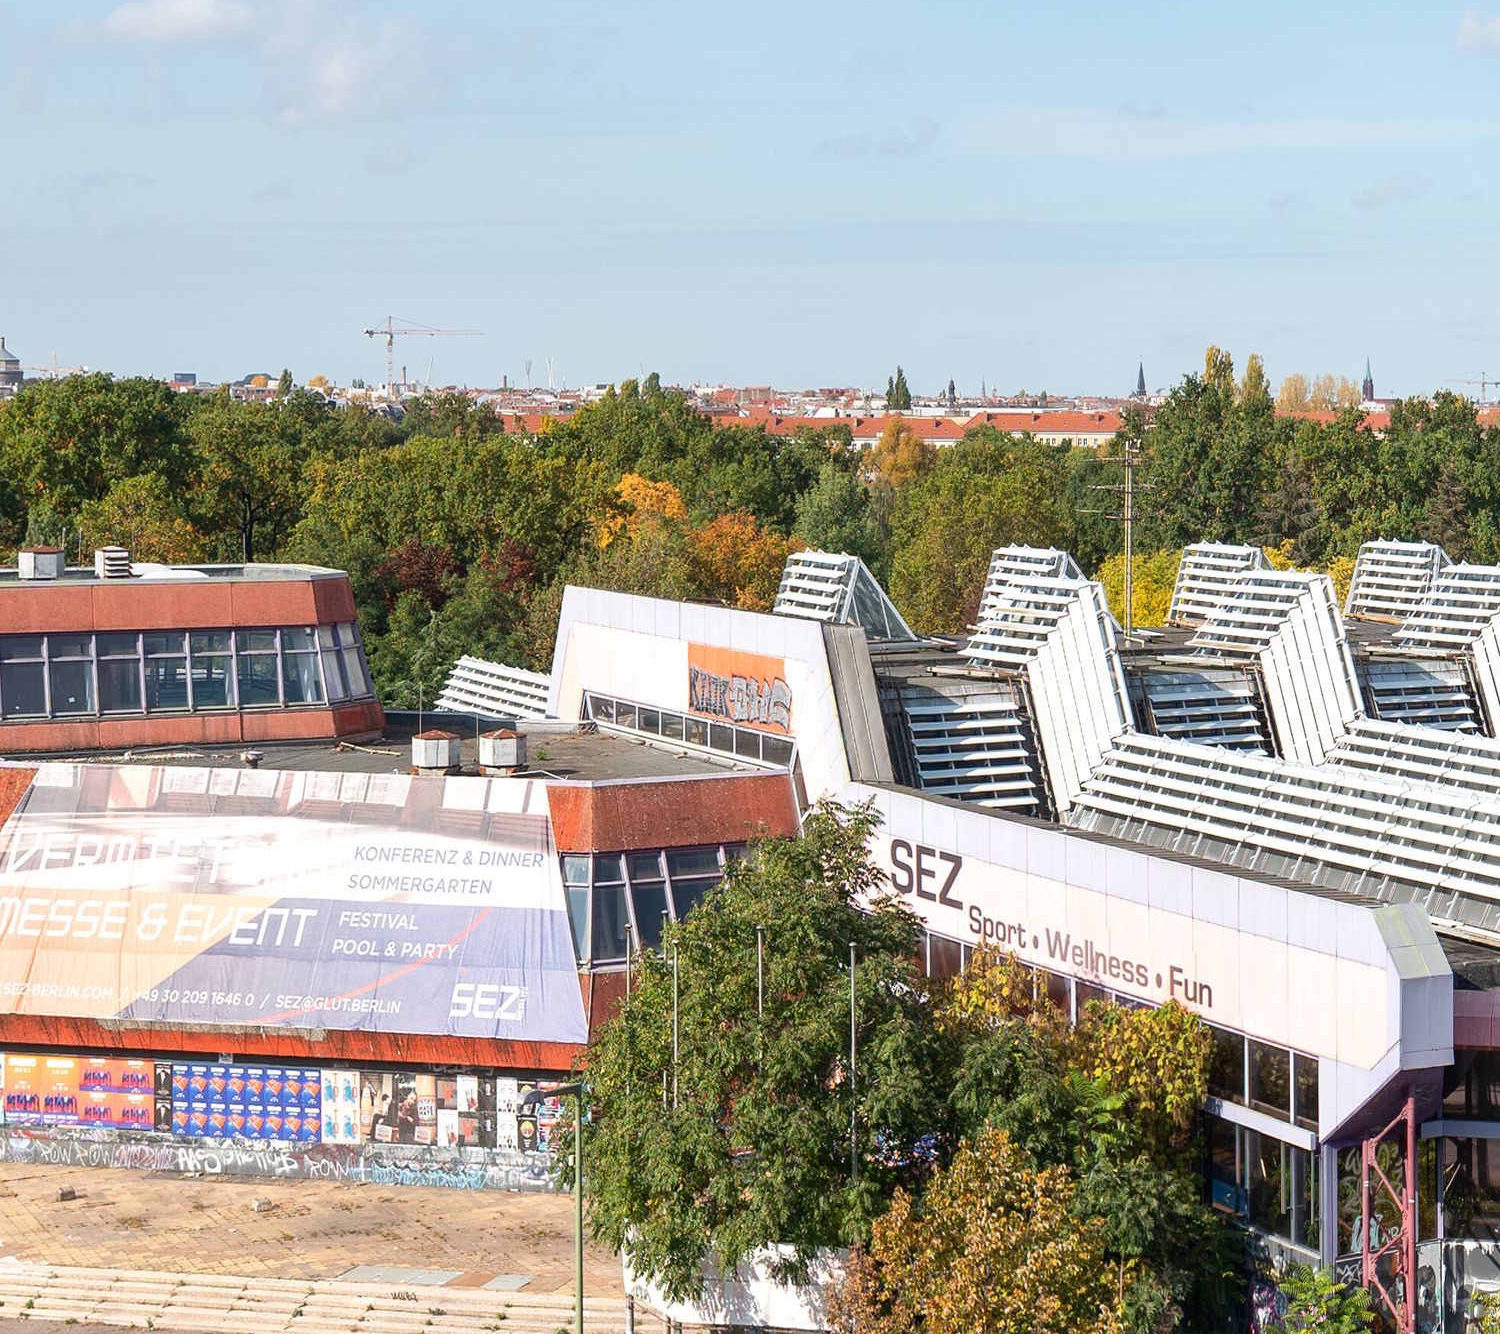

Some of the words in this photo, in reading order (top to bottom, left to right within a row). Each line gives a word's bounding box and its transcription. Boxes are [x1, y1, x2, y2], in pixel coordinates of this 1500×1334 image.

[354, 845, 459, 866] KONFERENZ
[462, 850, 474, 866] &
[479, 851, 546, 868] DINNER
[347, 873, 493, 895] SOMMERGARTEN
[890, 838, 964, 911] SEZ
[136, 902, 169, 941] &
[173, 903, 318, 947] EVENT
[338, 910, 419, 931] FESTIVAL
[331, 938, 380, 957] POOL
[384, 941, 397, 957] &
[400, 942, 460, 960] PARTY
[968, 904, 1027, 950] Sport
[1045, 926, 1149, 988] Wellness
[1169, 964, 1213, 1009] Fun
[161, 989, 179, 1004] 30
[181, 990, 207, 1005] 209
[210, 991, 242, 1007] 1646
[274, 994, 402, 1015] SEZ@GLUT.BERLIN
[449, 982, 522, 1021] SEZ
